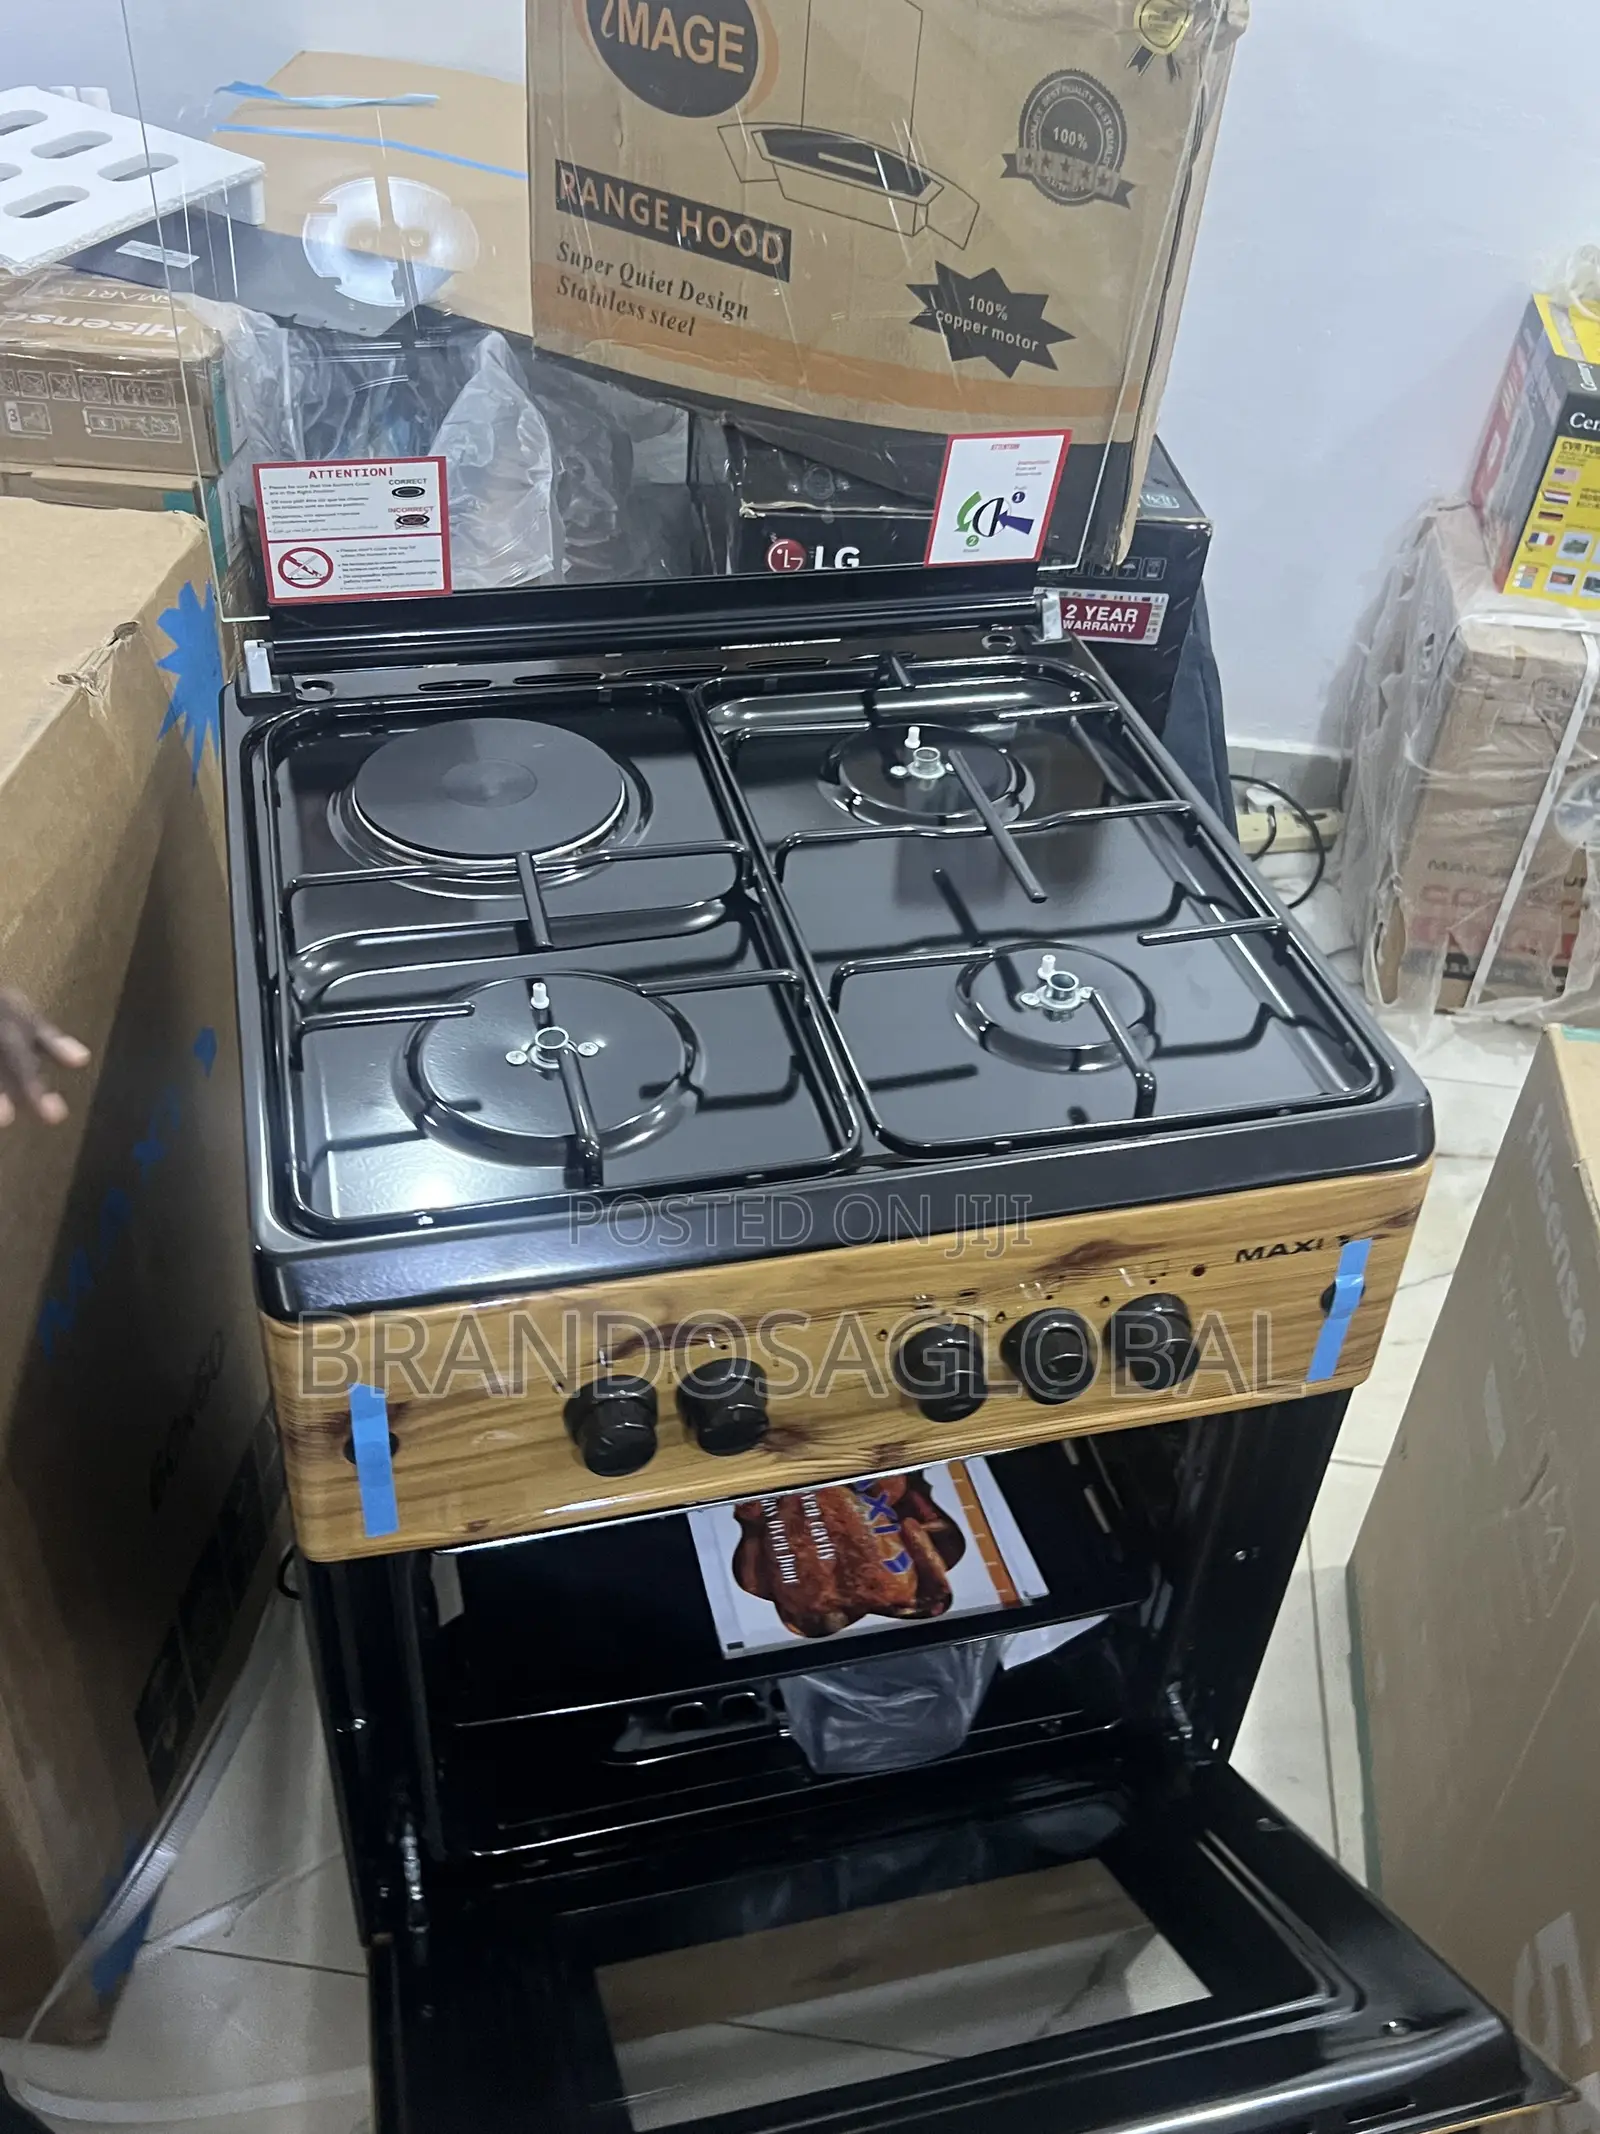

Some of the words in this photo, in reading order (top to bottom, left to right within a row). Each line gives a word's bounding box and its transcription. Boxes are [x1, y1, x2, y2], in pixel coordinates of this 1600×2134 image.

[1053, 126, 1088, 151] 100%
[560, 168, 670, 233] RANGE
[680, 205, 785, 266] HOOD
[556, 240, 614, 277] Super
[619, 261, 674, 297] Quiet
[678, 280, 750, 321] Design
[85, 287, 171, 304] SMART
[556, 274, 645, 321] Stainless
[649, 306, 697, 337] steel
[968, 294, 1008, 322] 100%
[1, 312, 188, 338] Hisense
[935, 309, 989, 336] copper
[991, 326, 1039, 352] motor
[308, 466, 393, 480] ATTENTION!
[388, 477, 428, 486] CORRECT
[387, 506, 435, 514] INCORRECT
[814, 545, 860, 570] LG
[1062, 619, 1136, 633] WARRANTY
[1064, 604, 1078, 619] 2
[1085, 605, 1139, 623] YEAR
[1527, 1102, 1586, 1359] Hisense
[1236, 1238, 1325, 1263] MAXI
